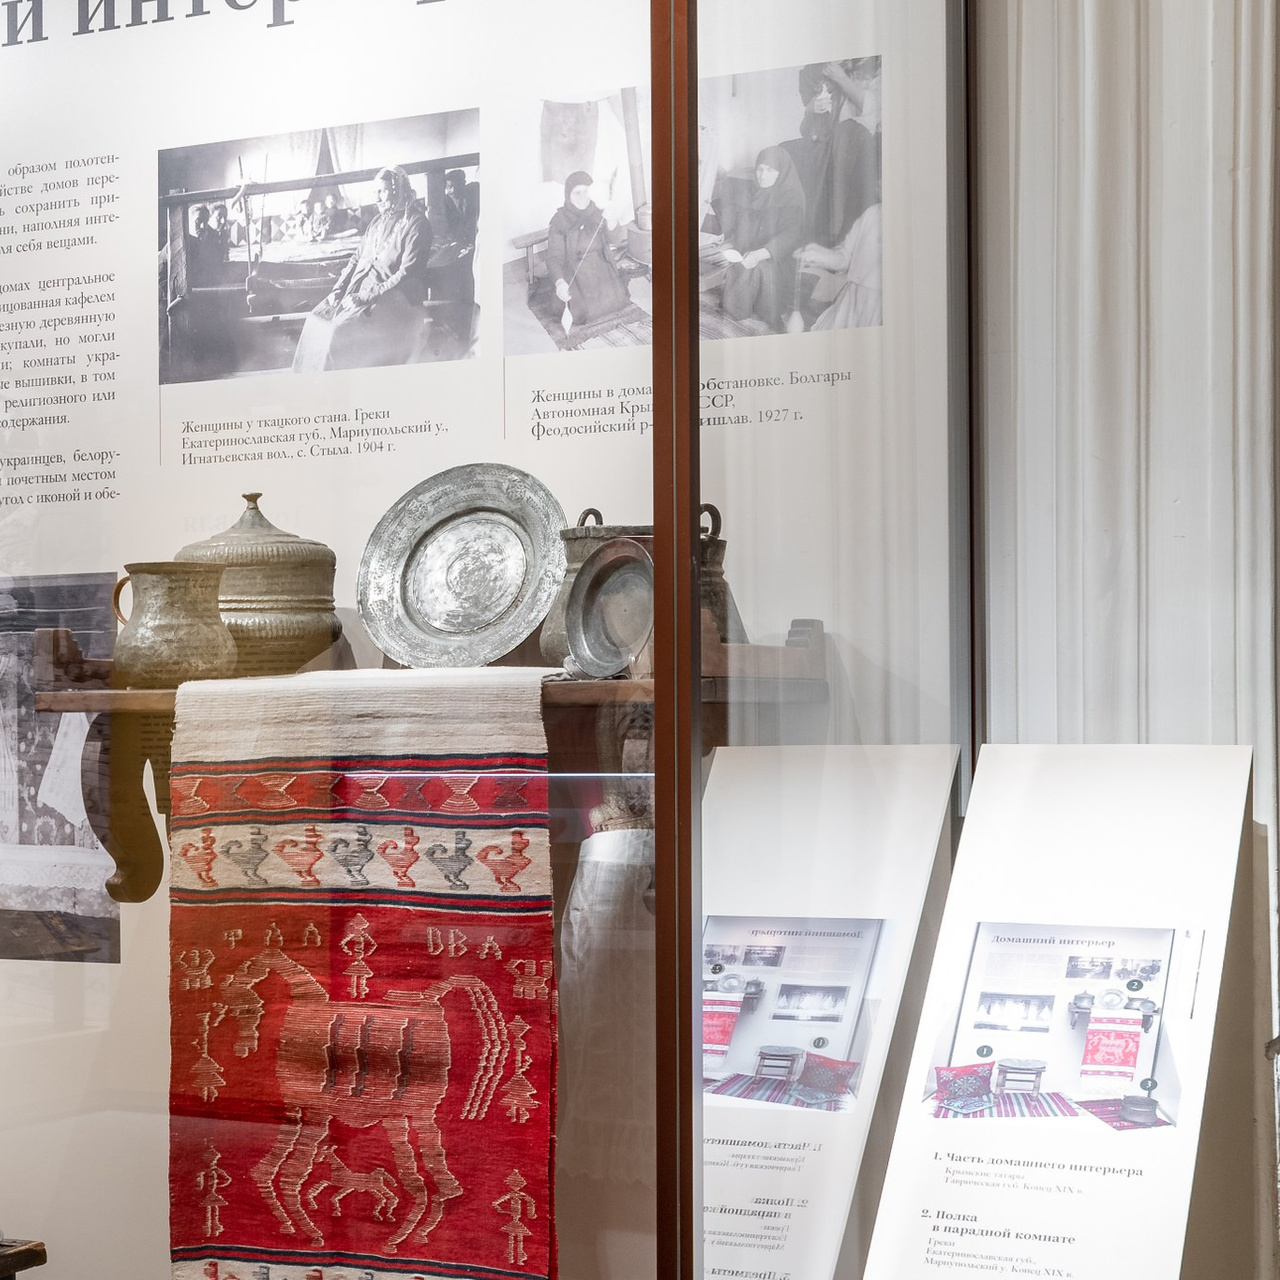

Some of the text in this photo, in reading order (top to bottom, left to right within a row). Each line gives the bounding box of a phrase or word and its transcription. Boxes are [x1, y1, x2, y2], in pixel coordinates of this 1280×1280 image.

[7, 161, 56, 179] образом
[64, 154, 119, 169] полотен-
[40, 178, 78, 194] домов
[86, 174, 119, 189] пере-
[14, 198, 80, 216] сохранить
[90, 194, 119, 208] при-
[22, 217, 80, 233] наполняя
[85, 213, 119, 225] инте-
[15, 237, 42, 253] себя
[46, 236, 97, 250] вещами.
[38, 272, 115, 291] центральное
[64, 290, 115, 309] кафелем
[39, 312, 115, 331] деревянную
[54, 336, 70, 346] но
[78, 332, 115, 344] могли
[22, 355, 76, 368] комнаты
[86, 351, 120, 367] укра-
[14, 375, 75, 388] вышивки,
[80, 373, 87, 383] в
[93, 371, 115, 382] том
[532, 389, 602, 404] Женщины
[789, 370, 852, 386] Болгары
[181, 408, 390, 433] Женщины у ткацкого стана. Греки
[532, 405, 615, 420] Автономная
[532, 419, 636, 440] Феодосийский
[700, 413, 752, 426] ишлав.
[758, 408, 789, 423] 1927
[793, 411, 803, 421] г.
[182, 420, 448, 450] Екатеринославская губ., Мариупольский у.,
[182, 439, 395, 465] Игнатьевская вол., с. Стыла. 1904 г.
[991, 934, 1115, 948] Домашний интерьер
[933, 1150, 1143, 1179] 1. Часть домашнего интерьера
[921, 1206, 977, 1221] 2. Полка
[943, 1226, 1011, 1238] парадной
[1014, 1232, 1075, 1244] комнате
